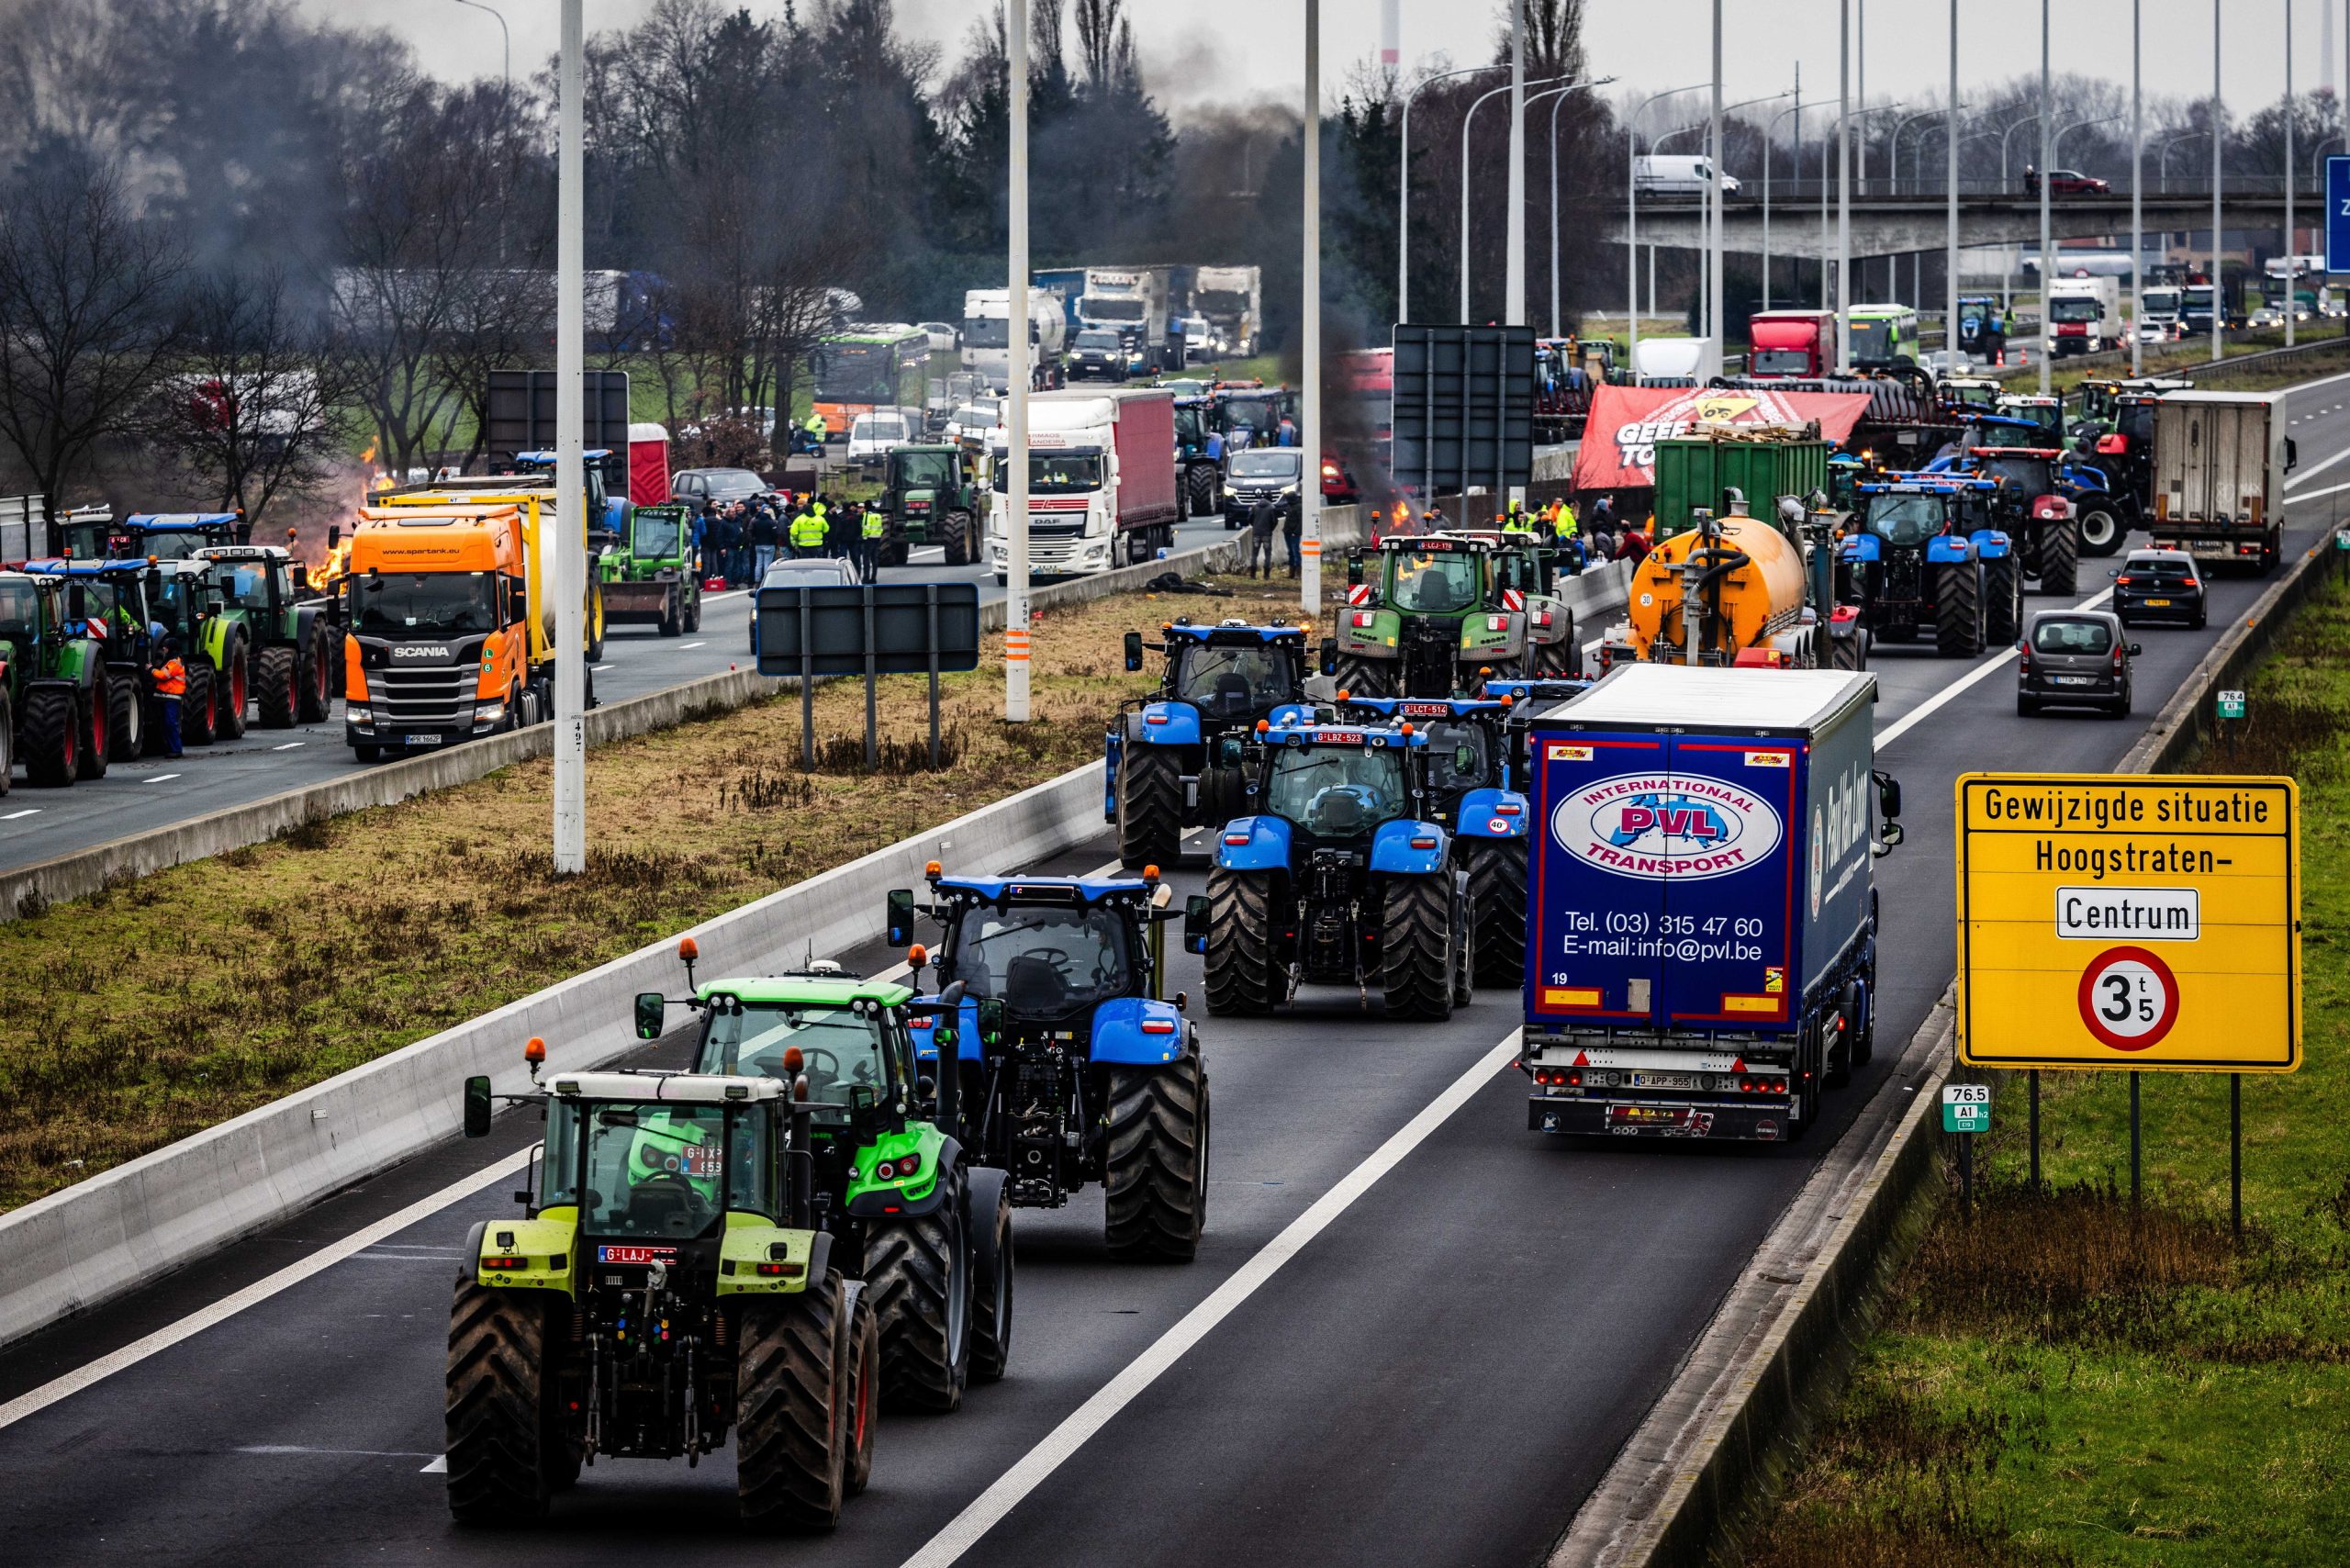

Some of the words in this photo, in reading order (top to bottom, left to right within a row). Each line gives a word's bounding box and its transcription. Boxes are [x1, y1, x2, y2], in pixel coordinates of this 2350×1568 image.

[1617, 420, 1689, 444] GEEF
[1642, 596, 1651, 604] 30
[394, 646, 450, 657] SCANIA
[485, 664, 491, 672] 6
[2223, 692, 2243, 700] 76.4
[1404, 705, 1446, 713] G-LCT-514
[1317, 734, 1361, 742] G-LBZ-523
[1583, 779, 1755, 813] INTERNATIONAAL
[1986, 788, 2144, 830] Gewijzigde
[2156, 790, 2269, 823] situatie
[1492, 821, 1503, 829] 40
[1619, 807, 1718, 837] PVL
[1585, 842, 1747, 874] TRANSPORT
[2035, 839, 2233, 880] Hoogstraten-
[2065, 896, 2190, 930] Centrum
[1564, 911, 1599, 932] Tel.
[1606, 911, 1650, 935] (03)
[1659, 915, 1695, 935] 315
[1701, 917, 1728, 936] 47
[1734, 918, 1763, 937] 60
[1563, 935, 1762, 963] E-mail:info@pvl.be
[1551, 972, 1568, 985] 19
[2101, 974, 2132, 1023] 3
[2138, 998, 2154, 1023] 5
[1953, 1088, 1986, 1102] 76.5
[1960, 1106, 1973, 1117] A1
